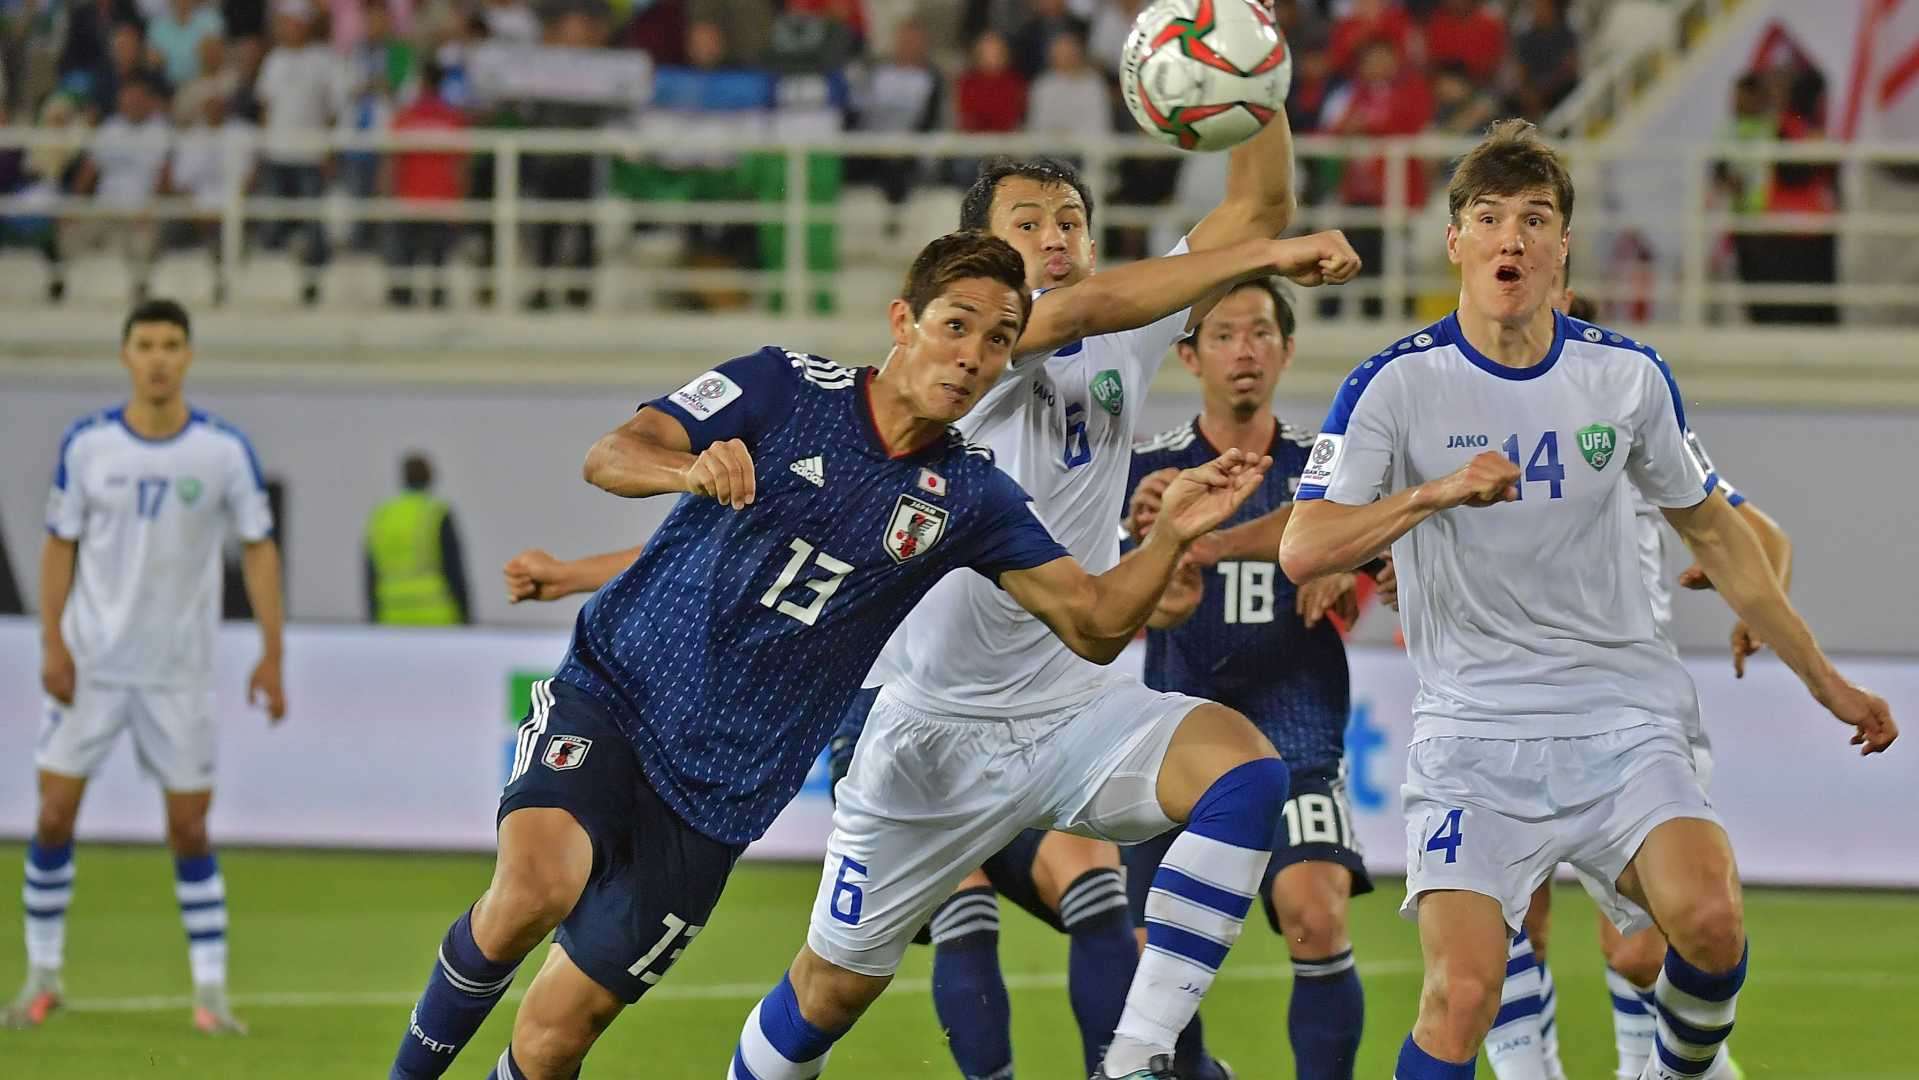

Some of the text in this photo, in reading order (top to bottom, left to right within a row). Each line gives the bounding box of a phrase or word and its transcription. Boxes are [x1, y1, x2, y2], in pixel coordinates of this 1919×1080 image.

[1094, 376, 1120, 401] UFA
[1063, 402, 1092, 469] 6
[1446, 433, 1489, 449] JAKO
[1581, 431, 1612, 451] UFA
[789, 462, 825, 488] adidas
[1502, 430, 1565, 501] 14
[137, 475, 169, 520] 17
[910, 500, 938, 515] JAPAN
[759, 537, 856, 627] 13
[1216, 560, 1276, 624] 18
[1281, 793, 1339, 848] 18
[1421, 808, 1464, 864] 4
[829, 856, 868, 926] 6
[410, 1003, 456, 1054] APAN
